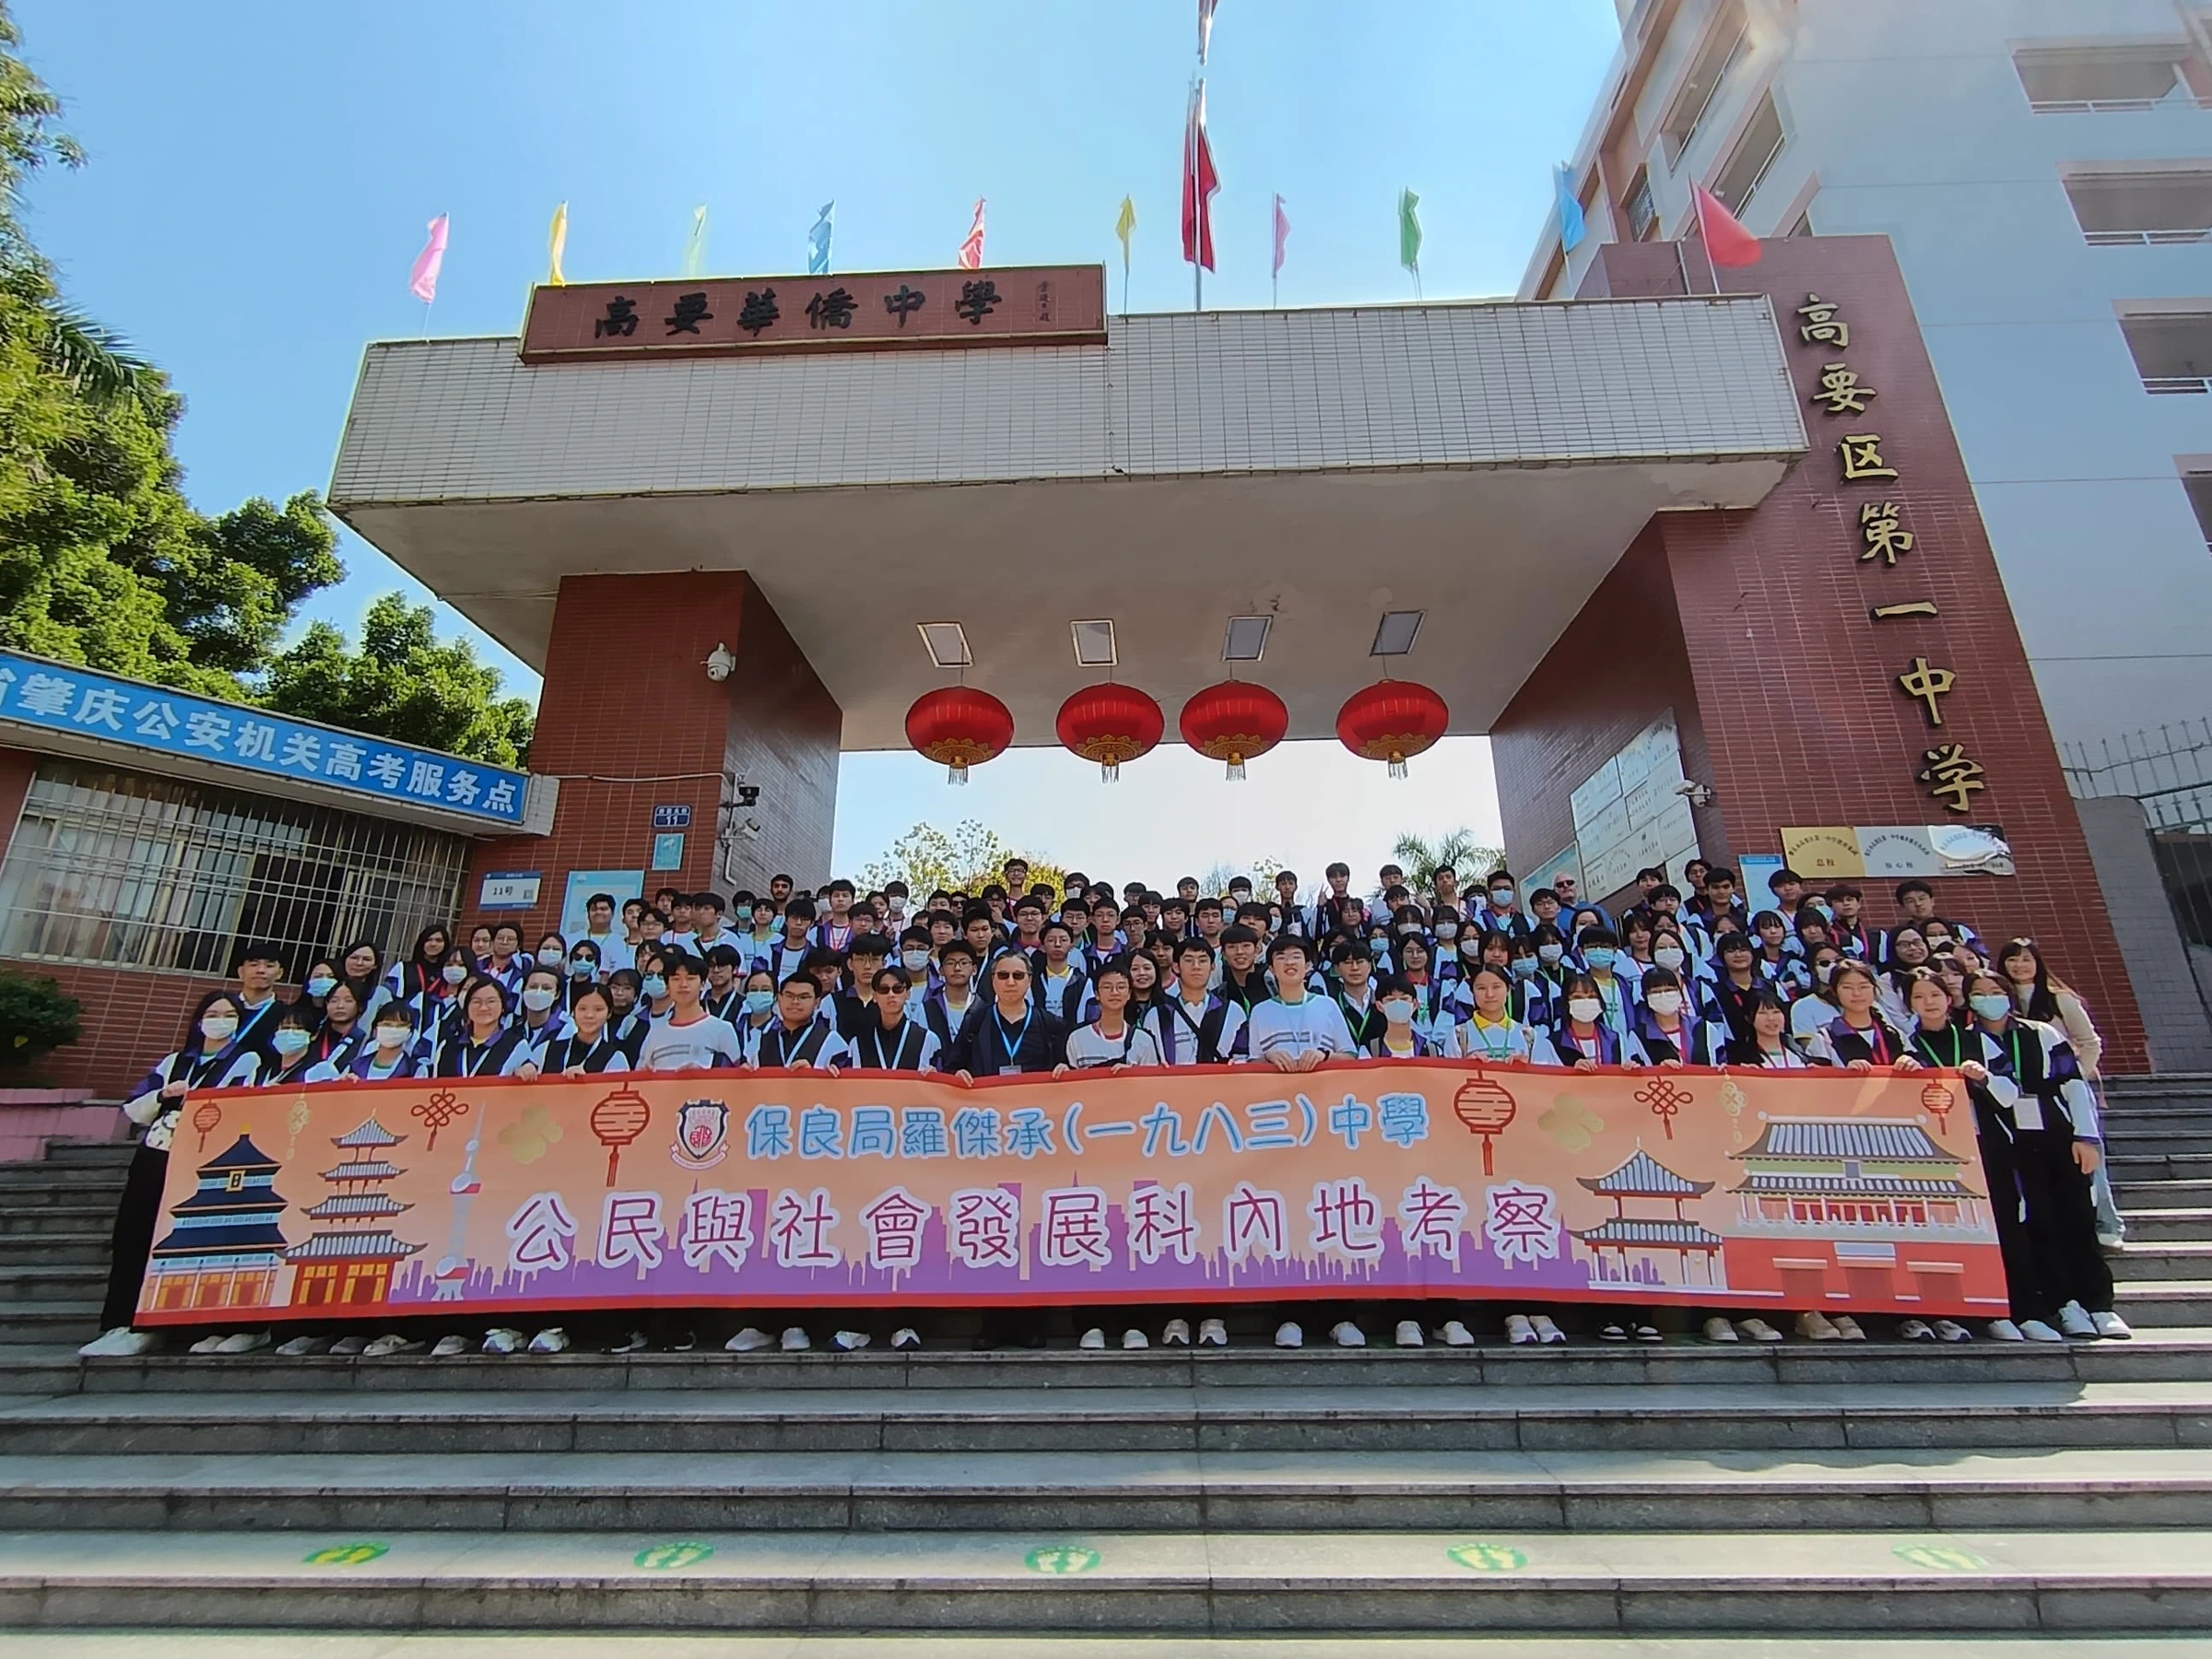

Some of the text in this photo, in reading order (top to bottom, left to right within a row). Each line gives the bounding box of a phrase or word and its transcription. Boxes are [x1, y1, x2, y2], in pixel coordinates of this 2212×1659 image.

[594, 280, 1003, 338] 高要華僑中學
[1796, 293, 1985, 813] 高要区第一中学
[666, 815, 678, 826] 11
[508, 1182, 1559, 1270] 公民與社會發展科內地考察
